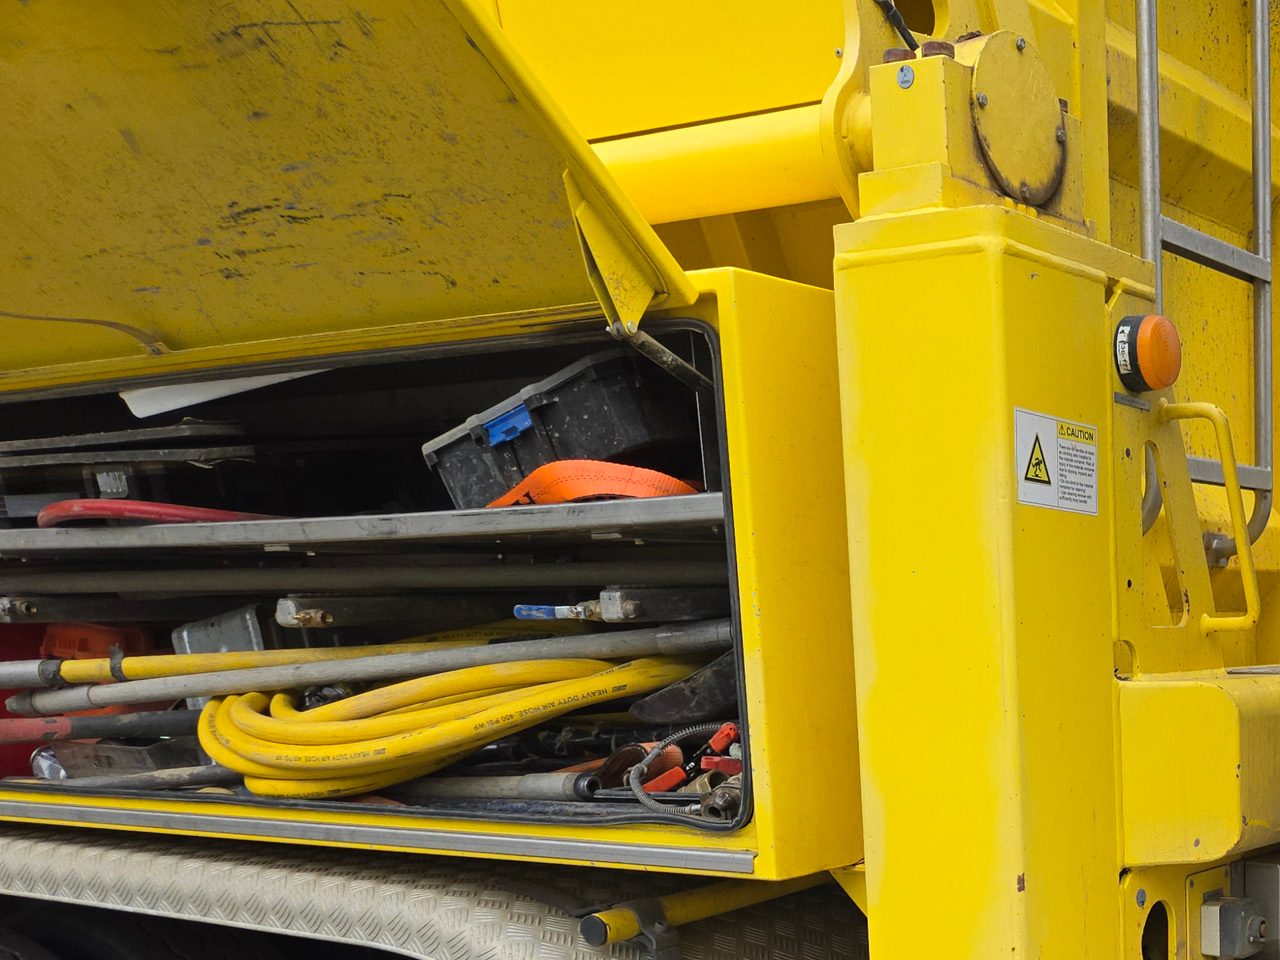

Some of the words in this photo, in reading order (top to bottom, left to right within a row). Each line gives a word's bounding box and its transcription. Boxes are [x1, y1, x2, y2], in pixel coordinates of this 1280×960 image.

[1066, 427, 1094, 441] CAUTION
[581, 688, 608, 700] HEAVY
[558, 694, 578, 706] DUTY
[542, 701, 556, 711] AIR
[487, 718, 500, 727] PSI
[501, 713, 515, 722] 400
[473, 722, 486, 731] WP
